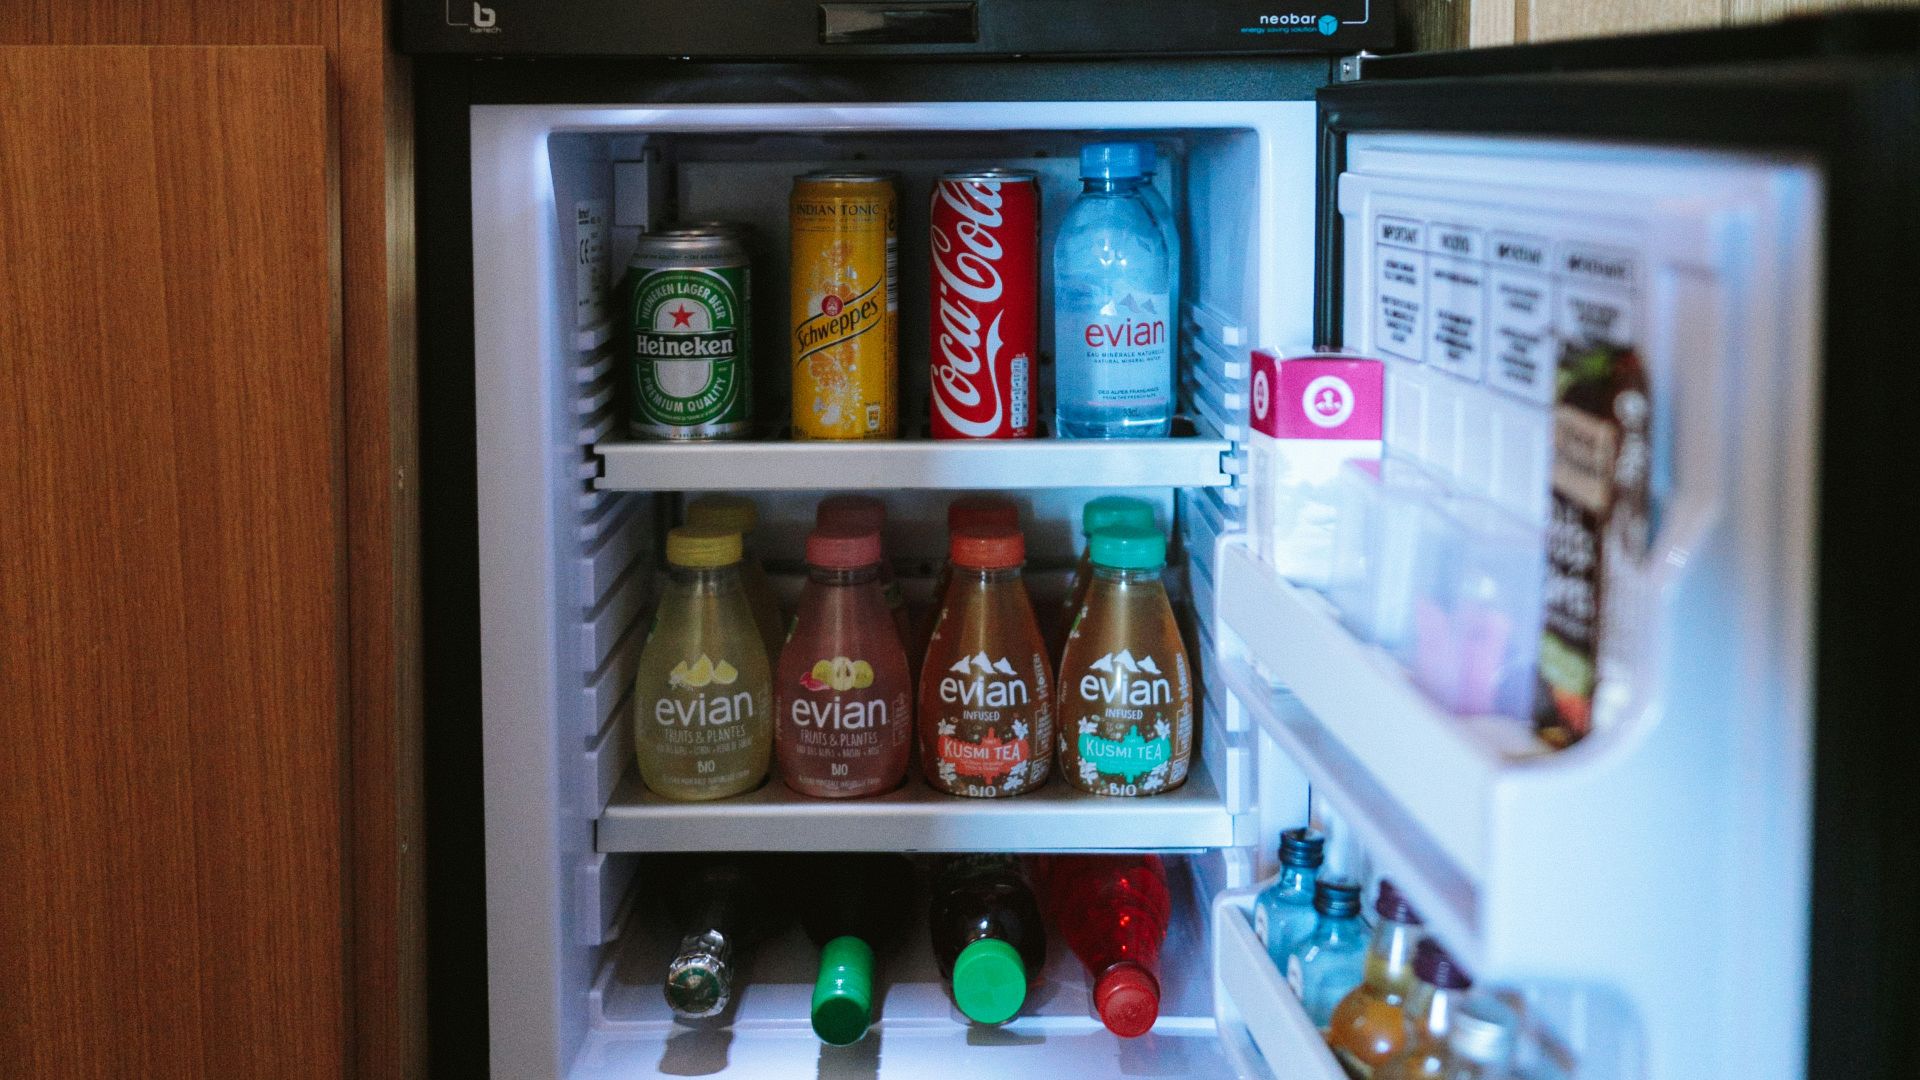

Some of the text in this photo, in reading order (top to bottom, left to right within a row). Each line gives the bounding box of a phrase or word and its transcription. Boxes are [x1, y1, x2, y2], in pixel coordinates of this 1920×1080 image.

[1260, 14, 1316, 25] neobar
[796, 203, 880, 216] INDIAN TONIC
[642, 282, 727, 320] HEINEKEN LAGER BEER
[796, 295, 879, 353] Schweppes
[1084, 318, 1165, 348] evian
[636, 334, 734, 356] Heineken
[643, 377, 726, 413] PREMIUM QUALITY
[940, 676, 1028, 707] evian
[1080, 674, 1170, 706] evian
[655, 691, 753, 727] evian
[791, 696, 887, 729] evian
[963, 710, 1000, 721] INFUSED
[1105, 708, 1143, 720] INFUSED
[664, 725, 746, 744] FRUITS & PLANTES
[800, 729, 878, 746] FRUITS & PLANTES
[944, 738, 1021, 760] KUSMI TEA
[1086, 738, 1162, 760] KUSMI TEA
[697, 760, 716, 773] BIO
[831, 763, 848, 776] BIO
[968, 784, 997, 797] BIO
[1109, 782, 1137, 796] BIO
